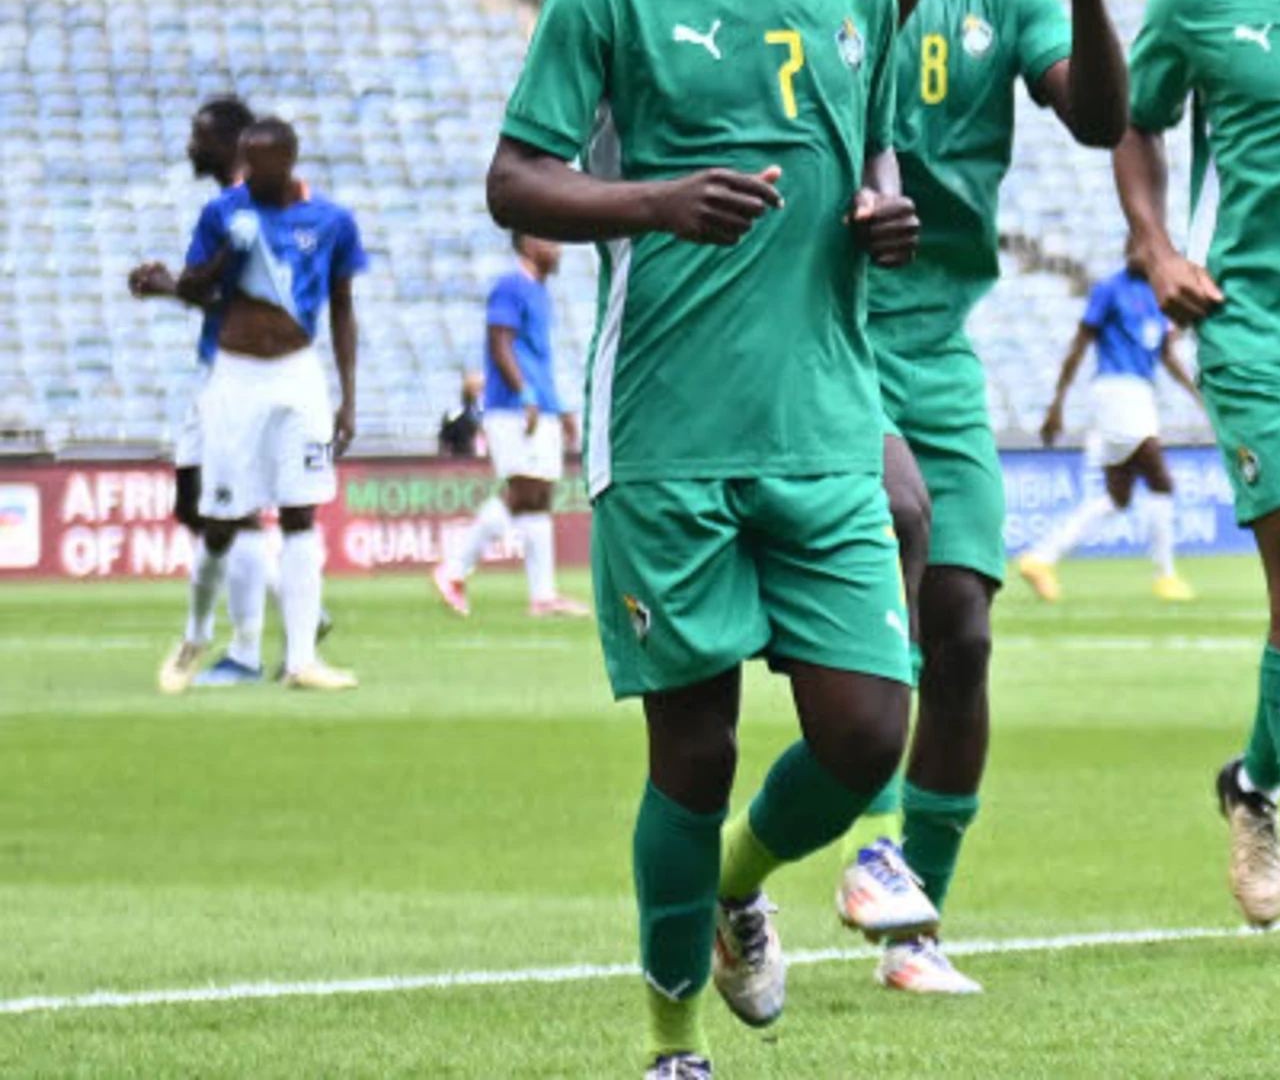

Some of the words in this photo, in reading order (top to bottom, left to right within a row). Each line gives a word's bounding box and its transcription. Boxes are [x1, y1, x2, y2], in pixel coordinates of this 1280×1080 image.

[764, 30, 803, 119] 7
[921, 33, 948, 104] 8
[62, 470, 177, 522] AFRI
[60, 524, 126, 576] OF
